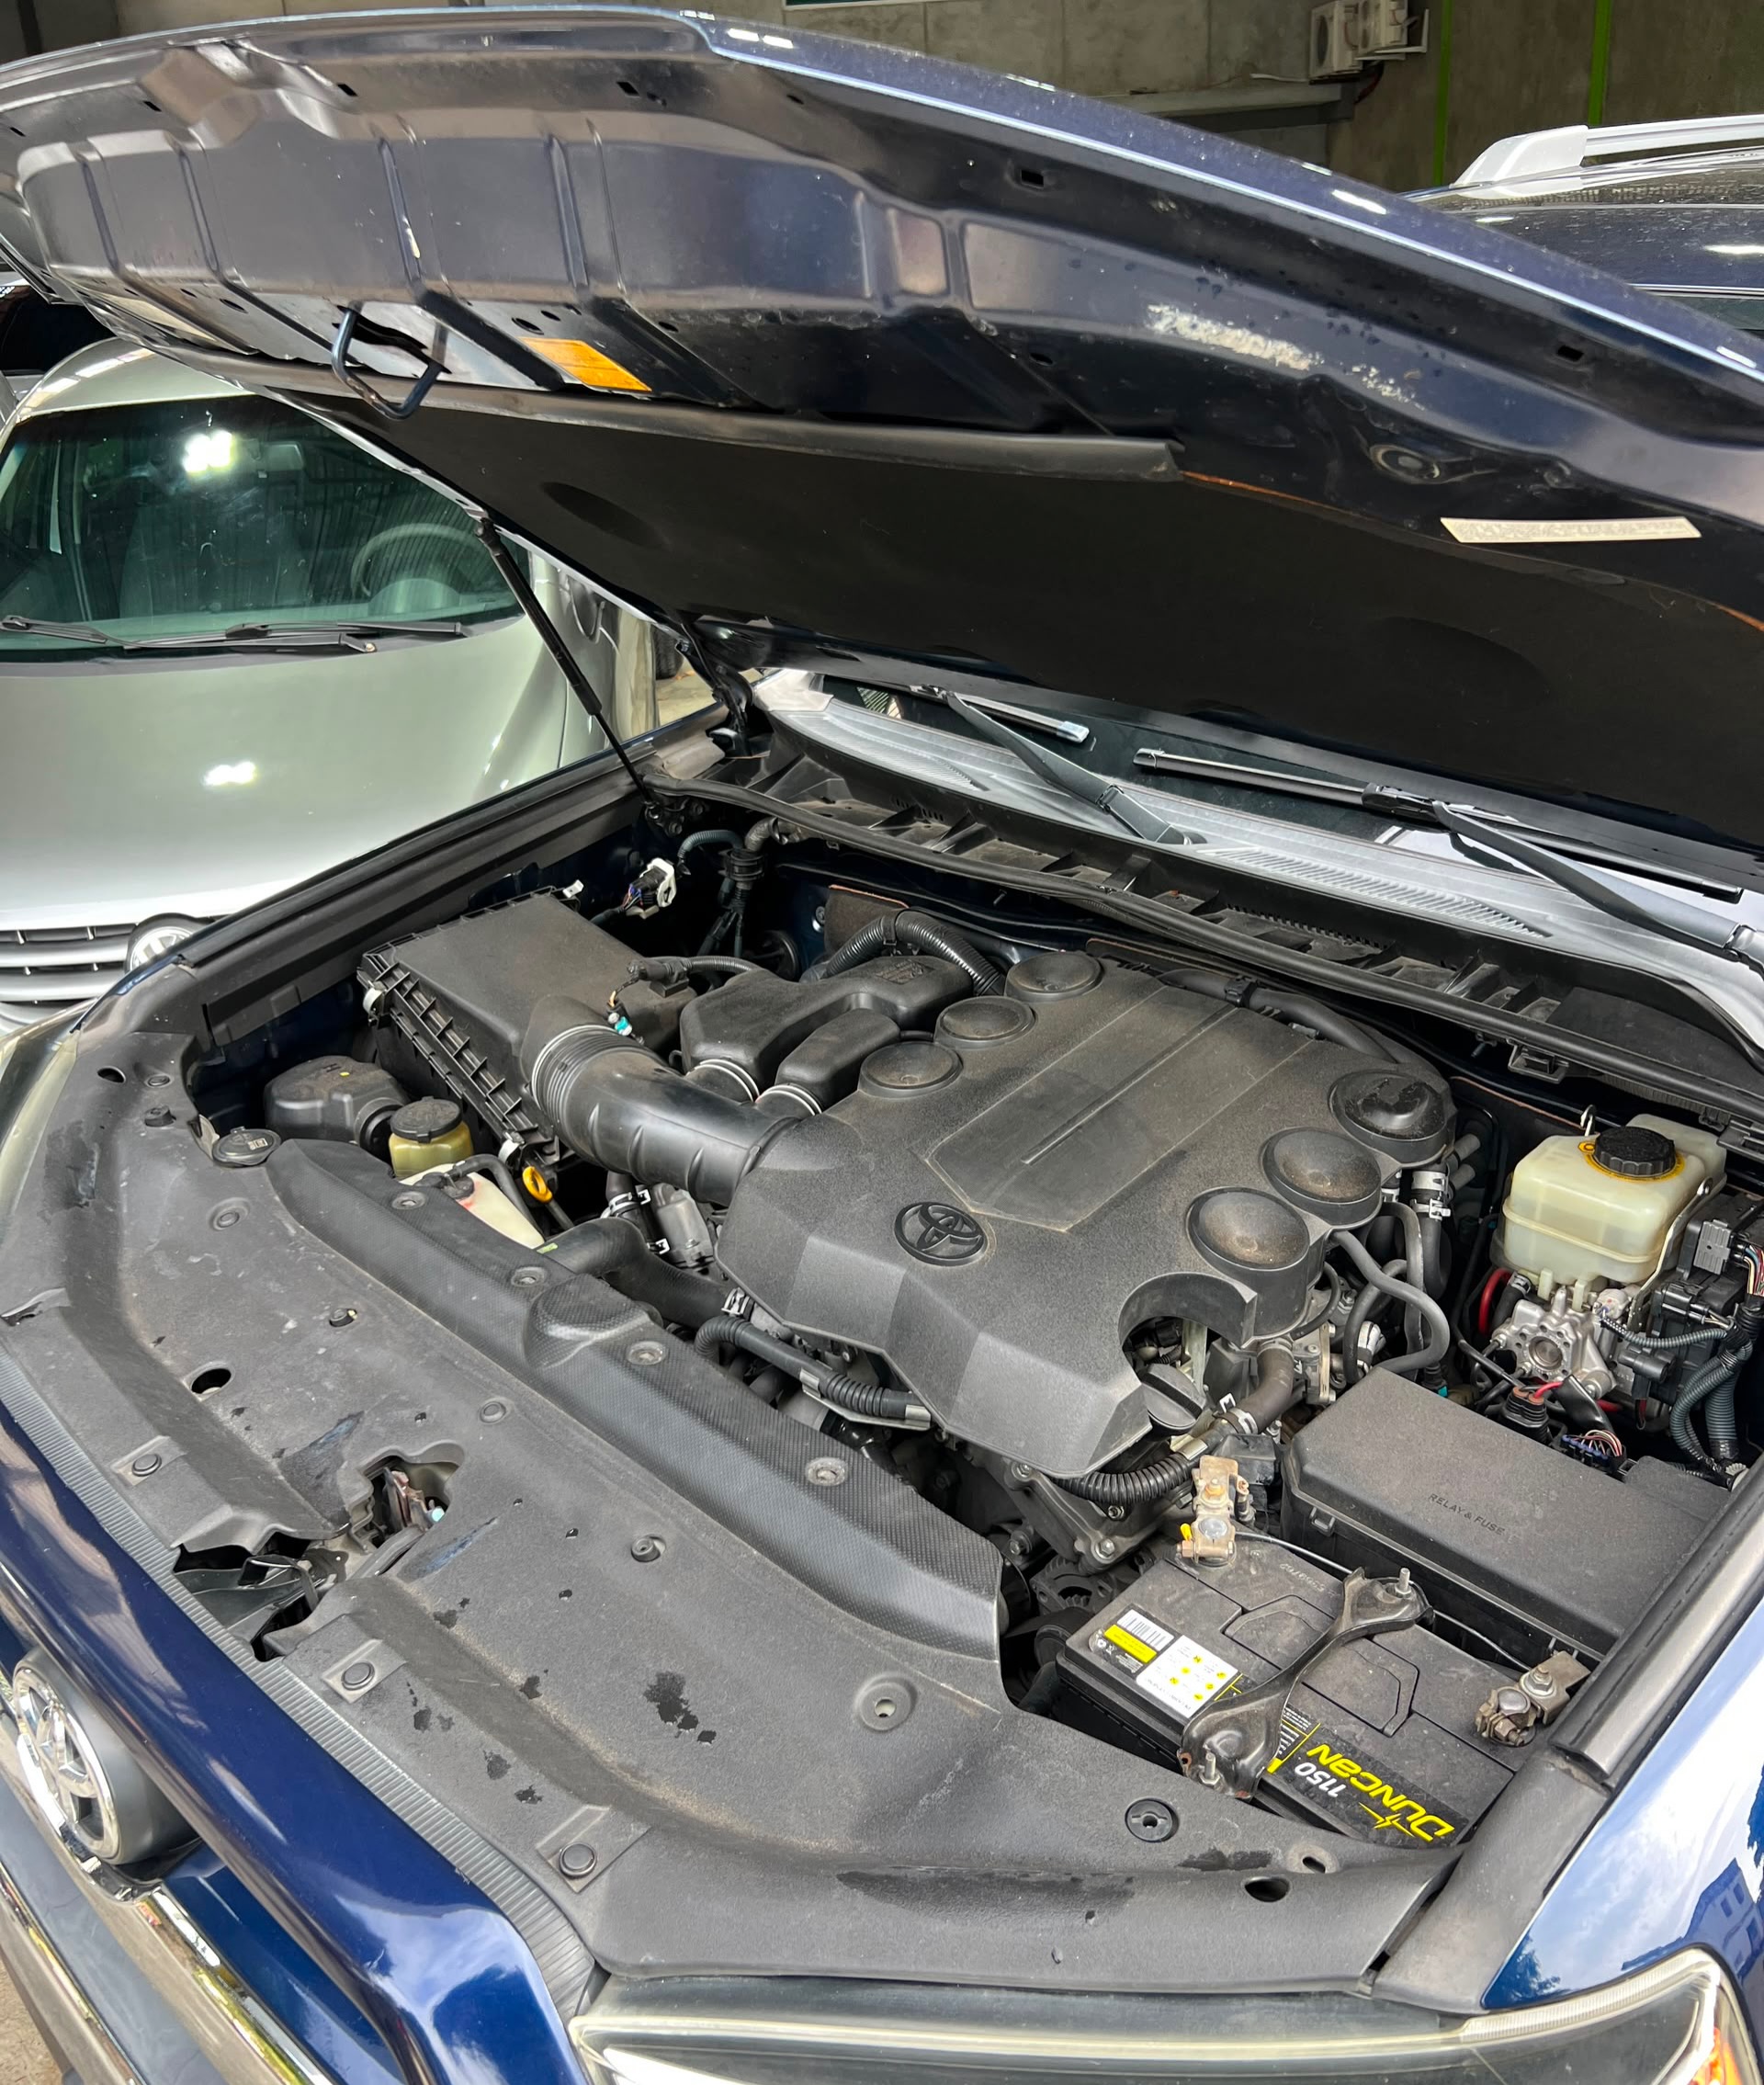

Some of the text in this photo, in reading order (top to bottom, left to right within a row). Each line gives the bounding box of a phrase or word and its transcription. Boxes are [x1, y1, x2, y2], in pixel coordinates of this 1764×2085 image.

[1428, 1493, 1507, 1536] RELAY & FUSE
[1294, 1762, 1347, 1798] 1150
